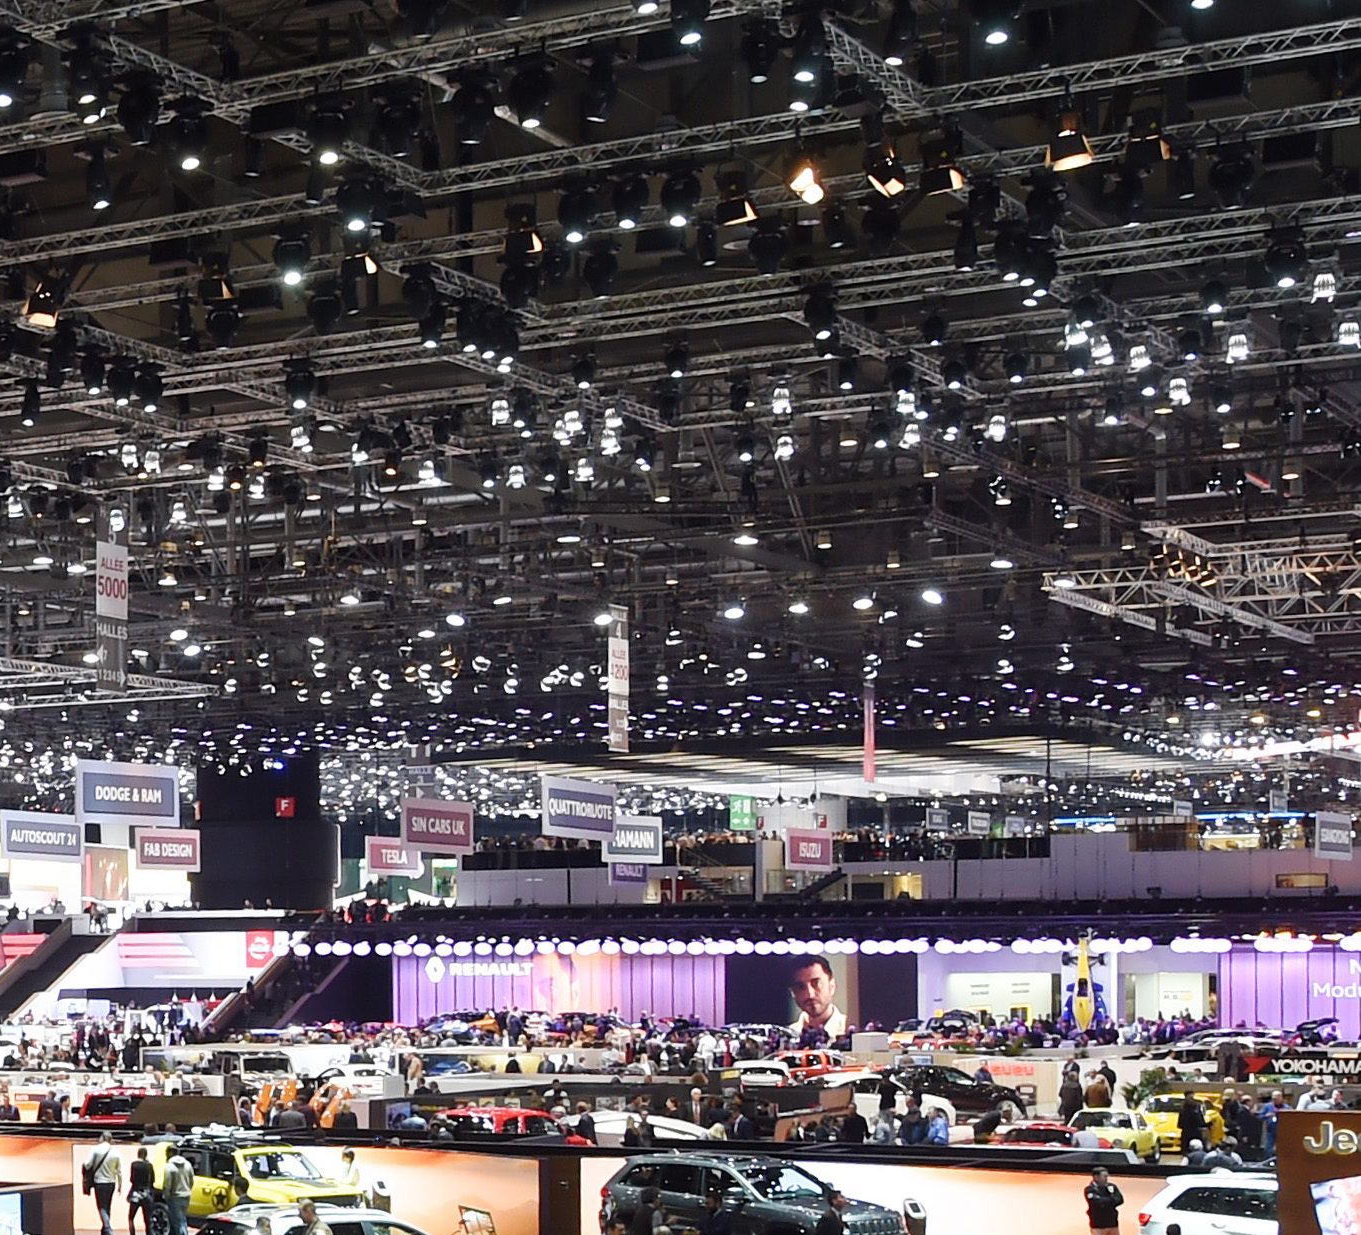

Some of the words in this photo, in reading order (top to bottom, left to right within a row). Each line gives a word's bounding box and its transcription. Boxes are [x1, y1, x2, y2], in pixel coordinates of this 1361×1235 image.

[97, 575, 127, 600] 5000
[96, 622, 128, 641] HALLES
[95, 786, 130, 803] DODGE
[133, 787, 139, 802] &
[141, 788, 162, 804] RAM
[281, 800, 288, 811] F
[411, 819, 427, 832] SIN
[428, 820, 451, 834] CARS
[452, 822, 465, 836] UK
[10, 828, 65, 846] AUTOSCOUT
[144, 842, 160, 857] FAB
[162, 843, 193, 858] DESIGN
[380, 849, 408, 865] TESLA
[799, 842, 822, 859] ISUZU
[449, 962, 534, 977] RENAULT
[1313, 982, 1361, 998] Mod
[1271, 1058, 1361, 1075] YOKOHAMA
[1303, 1121, 1361, 1155] Je
